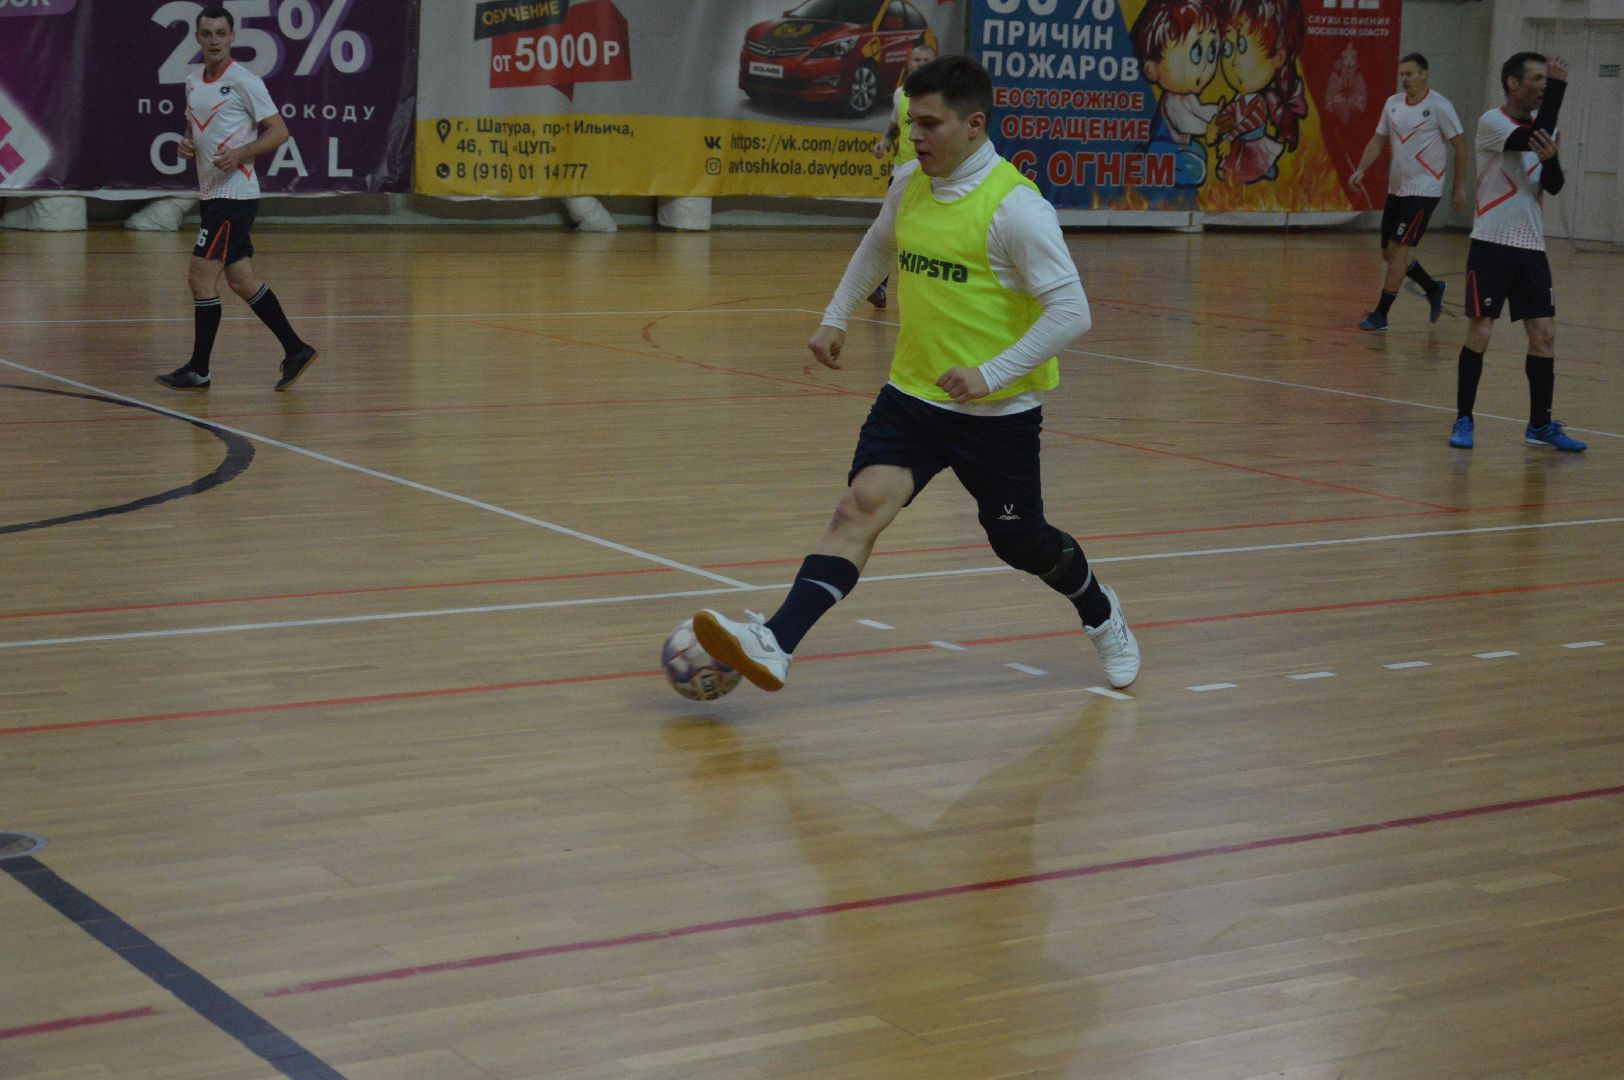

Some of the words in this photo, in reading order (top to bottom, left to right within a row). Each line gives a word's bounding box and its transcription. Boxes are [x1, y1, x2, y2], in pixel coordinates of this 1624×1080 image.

[481, 2, 560, 26] ОБУЧЕНИЕ
[982, 19, 1113, 50] ПРИЧИН
[514, 31, 597, 72] 5000
[981, 51, 1140, 82] ПОЖАРОВ
[138, 98, 174, 114] ПО
[281, 103, 375, 123] ОКОДУ
[993, 87, 1145, 111] ЕОСТОРОЖНОЕ
[476, 118, 536, 136] Шатура,
[574, 120, 635, 138] Ильича,
[1001, 115, 1151, 144] ОБРАЩЕНИЕ
[150, 131, 353, 177] GAL
[456, 139, 482, 156] 46,
[490, 139, 508, 156] ТЦ
[456, 163, 466, 180] 8
[473, 162, 513, 182] (916)
[518, 163, 534, 180] 01
[1010, 150, 1038, 182] С
[1047, 151, 1176, 188] ОГНЕМ
